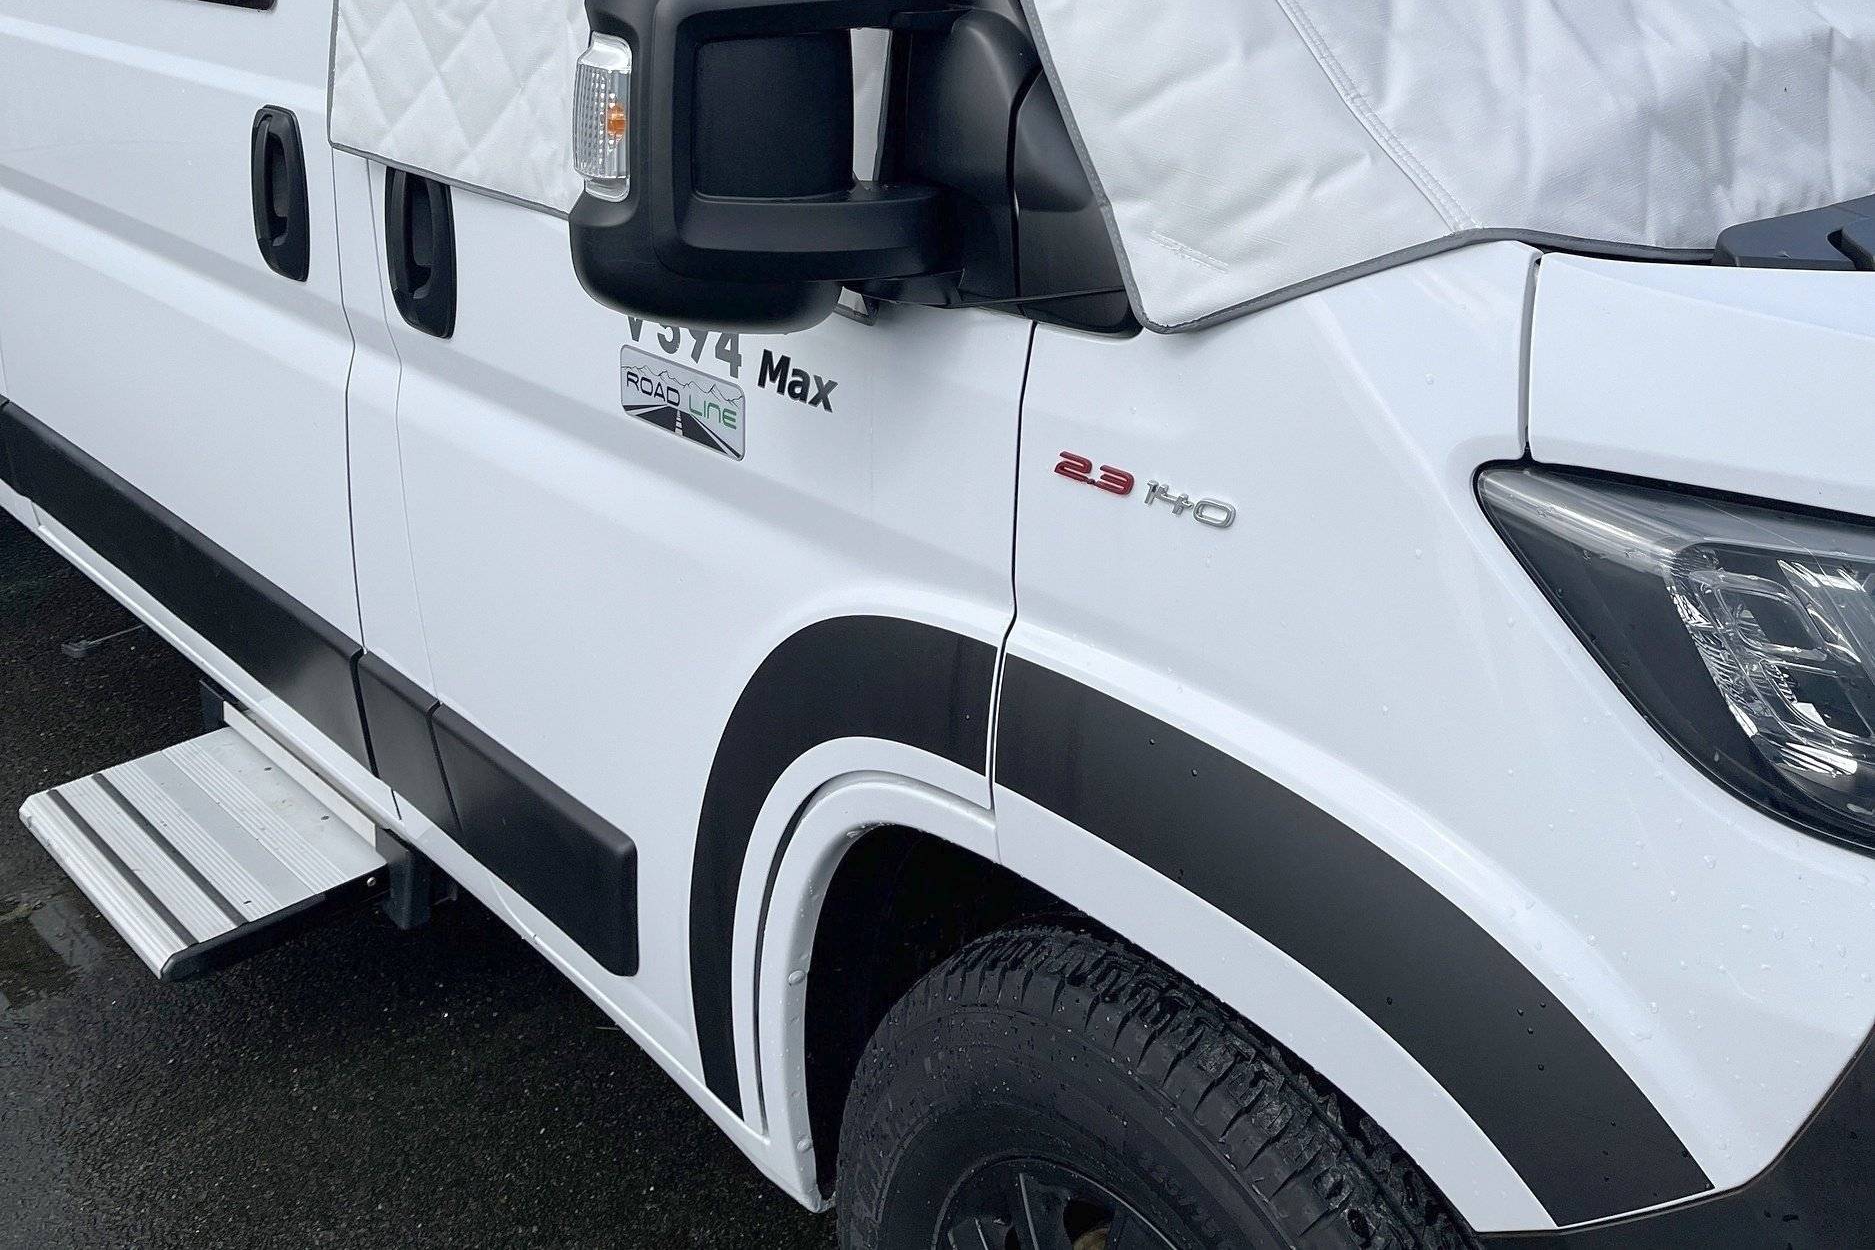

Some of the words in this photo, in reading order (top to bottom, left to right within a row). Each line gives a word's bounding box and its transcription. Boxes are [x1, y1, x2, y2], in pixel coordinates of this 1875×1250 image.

[626, 370, 681, 407] ROAD
[757, 348, 839, 413] Max
[1054, 451, 1135, 496] 2.3
[1144, 479, 1237, 529] 140
